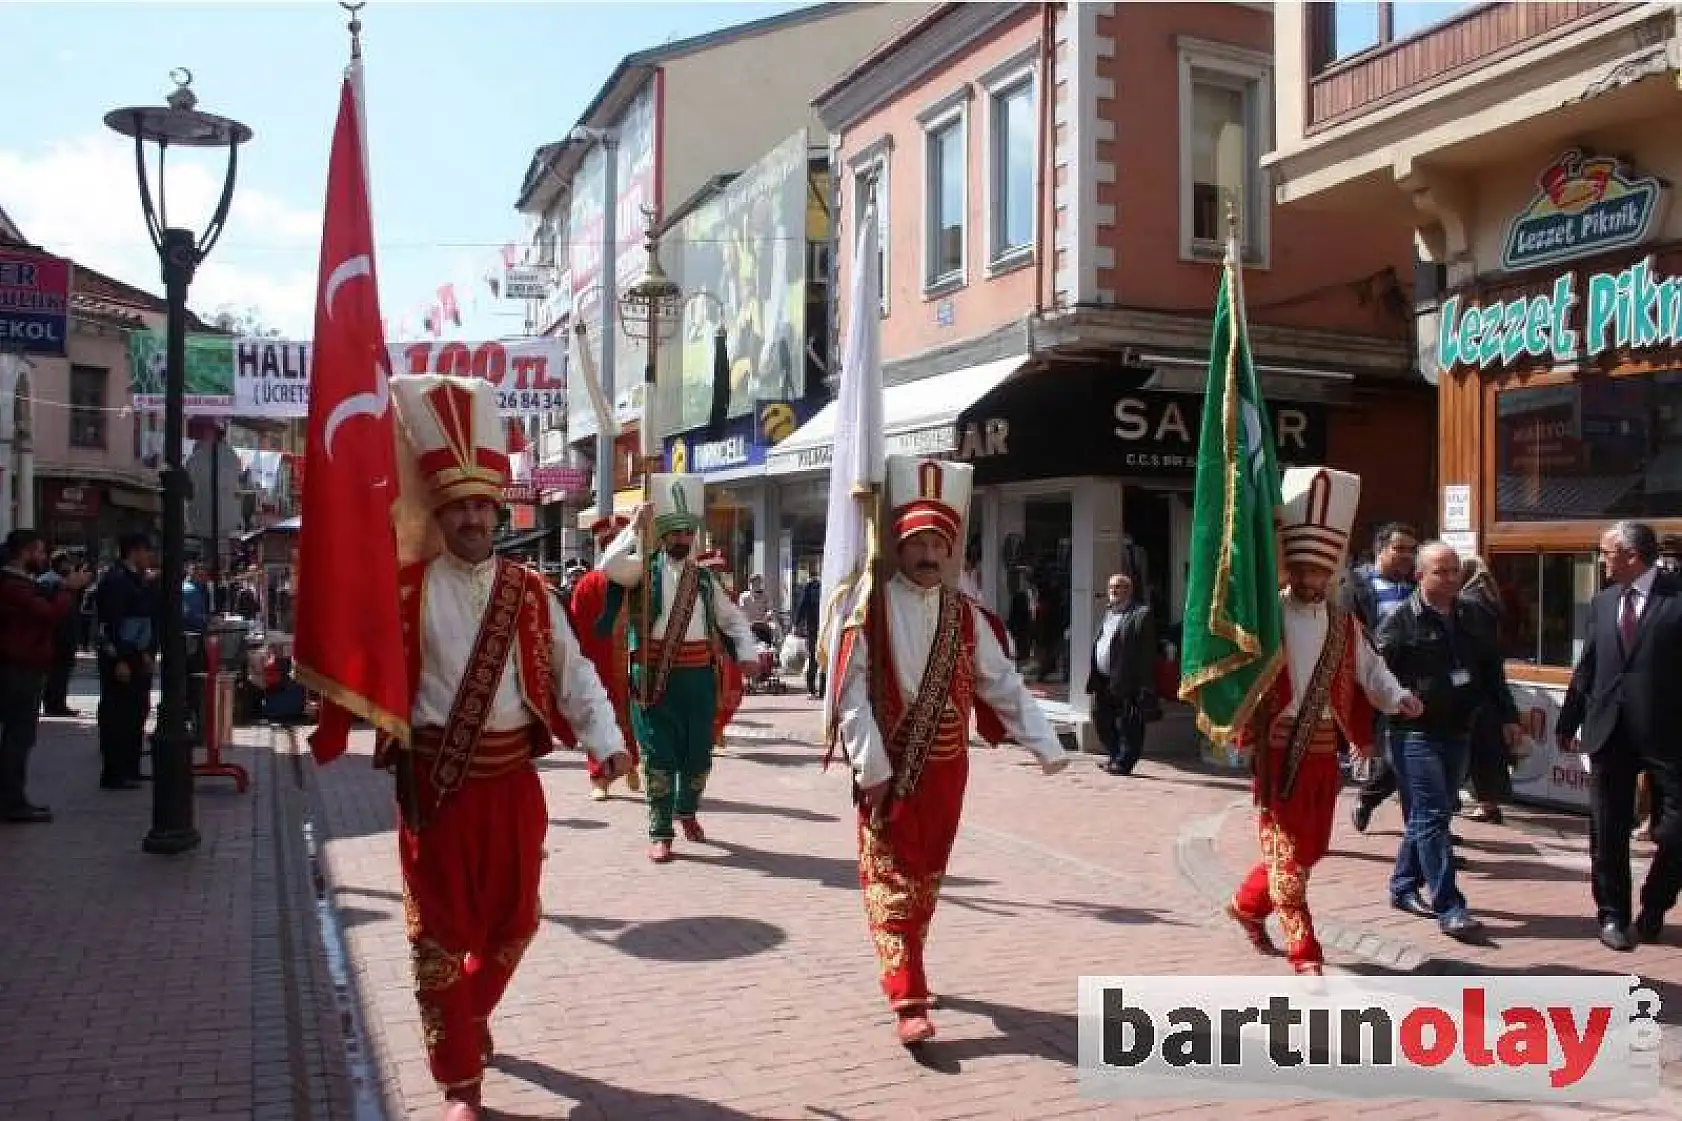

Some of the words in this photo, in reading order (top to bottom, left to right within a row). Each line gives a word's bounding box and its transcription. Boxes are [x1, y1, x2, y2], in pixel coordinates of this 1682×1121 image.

[1517, 217, 1576, 253] Lezzet
[1580, 201, 1639, 239] Piknik
[1438, 271, 1580, 372] Lezzet
